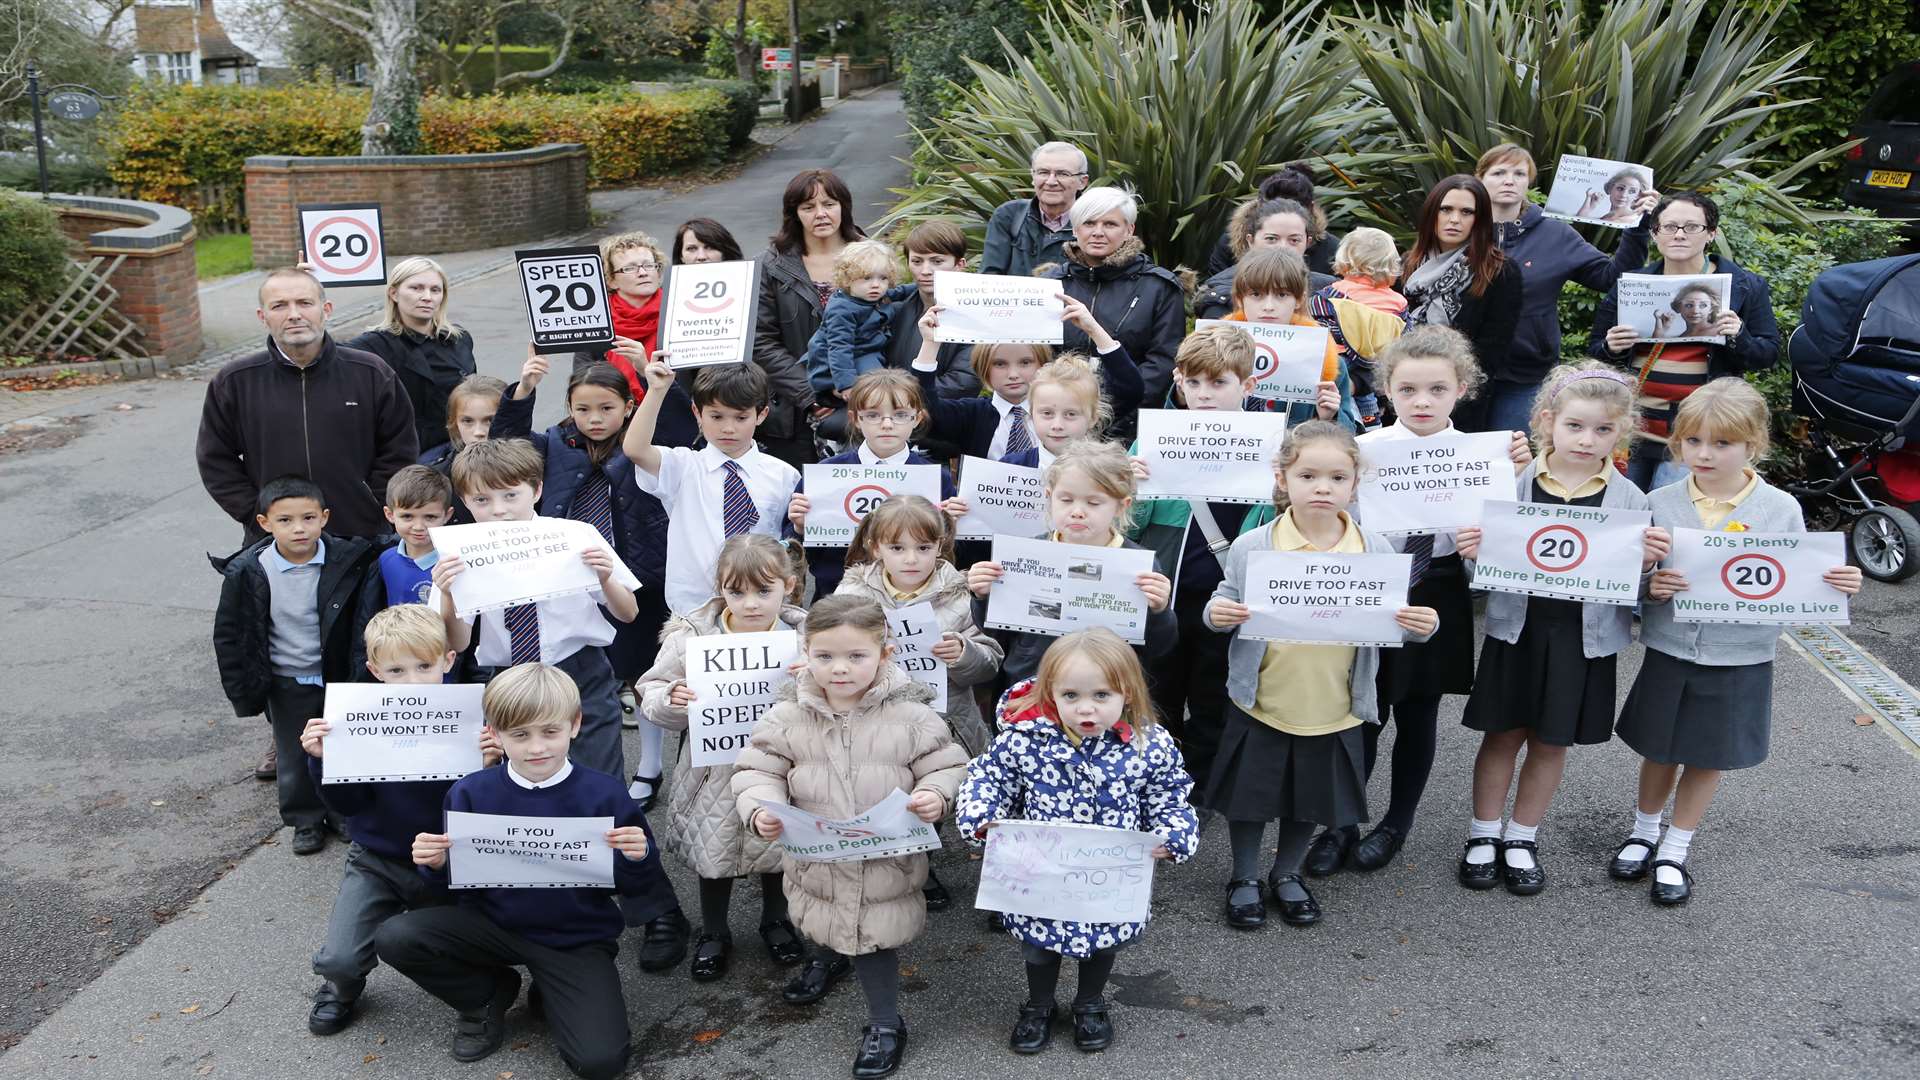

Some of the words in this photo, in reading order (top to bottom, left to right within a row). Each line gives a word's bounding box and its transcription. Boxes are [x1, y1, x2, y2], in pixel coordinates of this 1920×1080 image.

[66, 102, 80, 112] 63
[320, 234, 368, 258] 20
[528, 262, 595, 281] SPEED
[694, 280, 727, 300] 20
[535, 282, 596, 314] 20
[956, 298, 980, 306] YOU
[982, 298, 1018, 306] WON'T
[1022, 298, 1045, 306] SEE
[988, 310, 1014, 318] HER
[538, 318, 550, 328] IS
[554, 314, 602, 326] PLENTY
[676, 318, 722, 327] Twenty
[724, 316, 734, 324] is
[549, 332, 572, 340] RIGHT
[682, 326, 729, 336] enough
[1253, 326, 1295, 340] Plenty
[1255, 355, 1269, 371] 0
[1254, 382, 1280, 394] ople
[1284, 384, 1312, 395] Live
[1190, 422, 1200, 432] IF
[1204, 424, 1232, 432] YOU
[1158, 436, 1196, 446] DRIVE
[1200, 438, 1227, 446] TOO
[1230, 438, 1264, 448] FAST
[1160, 450, 1186, 460] YOU
[1189, 451, 1232, 461] WON'T
[1235, 452, 1260, 462] SEE
[1410, 450, 1422, 460] IF
[1426, 448, 1456, 458] YOU
[832, 468, 860, 478] 20's
[864, 468, 908, 481] Plenty
[1198, 464, 1224, 473] HIM
[1378, 465, 1420, 478] DRIVE
[1423, 464, 1453, 474] TOO
[1456, 460, 1492, 472] FAST
[1008, 475, 1018, 484] IF
[1381, 482, 1410, 492] YOU
[1413, 478, 1460, 490] WON'T
[1463, 476, 1491, 486] SEE
[978, 484, 1013, 496] DRIVE
[1016, 488, 1042, 498] TOO
[1424, 492, 1454, 502] HER
[855, 497, 883, 514] 20
[978, 496, 1004, 506] YOU
[1006, 500, 1045, 511] WON'T
[1012, 511, 1040, 520] HER
[1516, 505, 1550, 516] 20's
[1556, 508, 1609, 523] Plenty
[502, 526, 530, 534] YOU
[806, 526, 850, 536] Where
[460, 538, 502, 555] DRIVE
[504, 536, 531, 548] TOO
[1538, 538, 1576, 559] 20
[1703, 536, 1737, 548] 20's
[1743, 538, 1800, 549] Plenty
[466, 555, 496, 570] YOU
[497, 548, 542, 565] WON'T
[544, 542, 570, 555] SEE
[1001, 560, 1020, 568] DRIVE
[1010, 566, 1031, 574] WON'T
[1306, 566, 1318, 574] IF
[1322, 566, 1352, 575] YOU
[1734, 566, 1772, 586] 20
[1476, 565, 1528, 582] Where
[1534, 573, 1590, 589] People
[1596, 579, 1631, 592] Live
[1268, 580, 1312, 590] DRIVE
[1316, 580, 1346, 590] TOO
[1350, 581, 1386, 590] FAST
[1068, 600, 1082, 608] YOU
[1098, 598, 1113, 606] TOO
[1270, 596, 1300, 606] YOU
[1303, 596, 1350, 606] WON'T
[1354, 596, 1382, 606] SEE
[1674, 600, 1730, 612] Where
[1735, 601, 1796, 615] People
[1802, 602, 1840, 613] Live
[1310, 610, 1342, 619] HER
[893, 643, 918, 656] UR
[703, 646, 781, 672] KILL
[714, 681, 770, 698] YOUR
[382, 697, 394, 706] IF
[398, 697, 427, 706] YOU
[346, 712, 389, 722] DRIVE
[392, 711, 422, 720] TOO
[426, 710, 462, 720] FAST
[348, 726, 378, 736] YOU
[381, 725, 428, 735] WON'T
[432, 724, 459, 734] SEE
[392, 738, 418, 748] HIM
[702, 734, 750, 752] NOT
[507, 828, 520, 836] IF
[523, 828, 554, 837] YOU
[471, 838, 516, 848] DRIVE
[518, 840, 550, 850] TOO
[554, 841, 591, 850] FAST
[784, 842, 834, 856] Where
[475, 846, 506, 855] YOU
[508, 850, 556, 860] WON'T
[560, 854, 588, 862] SEE
